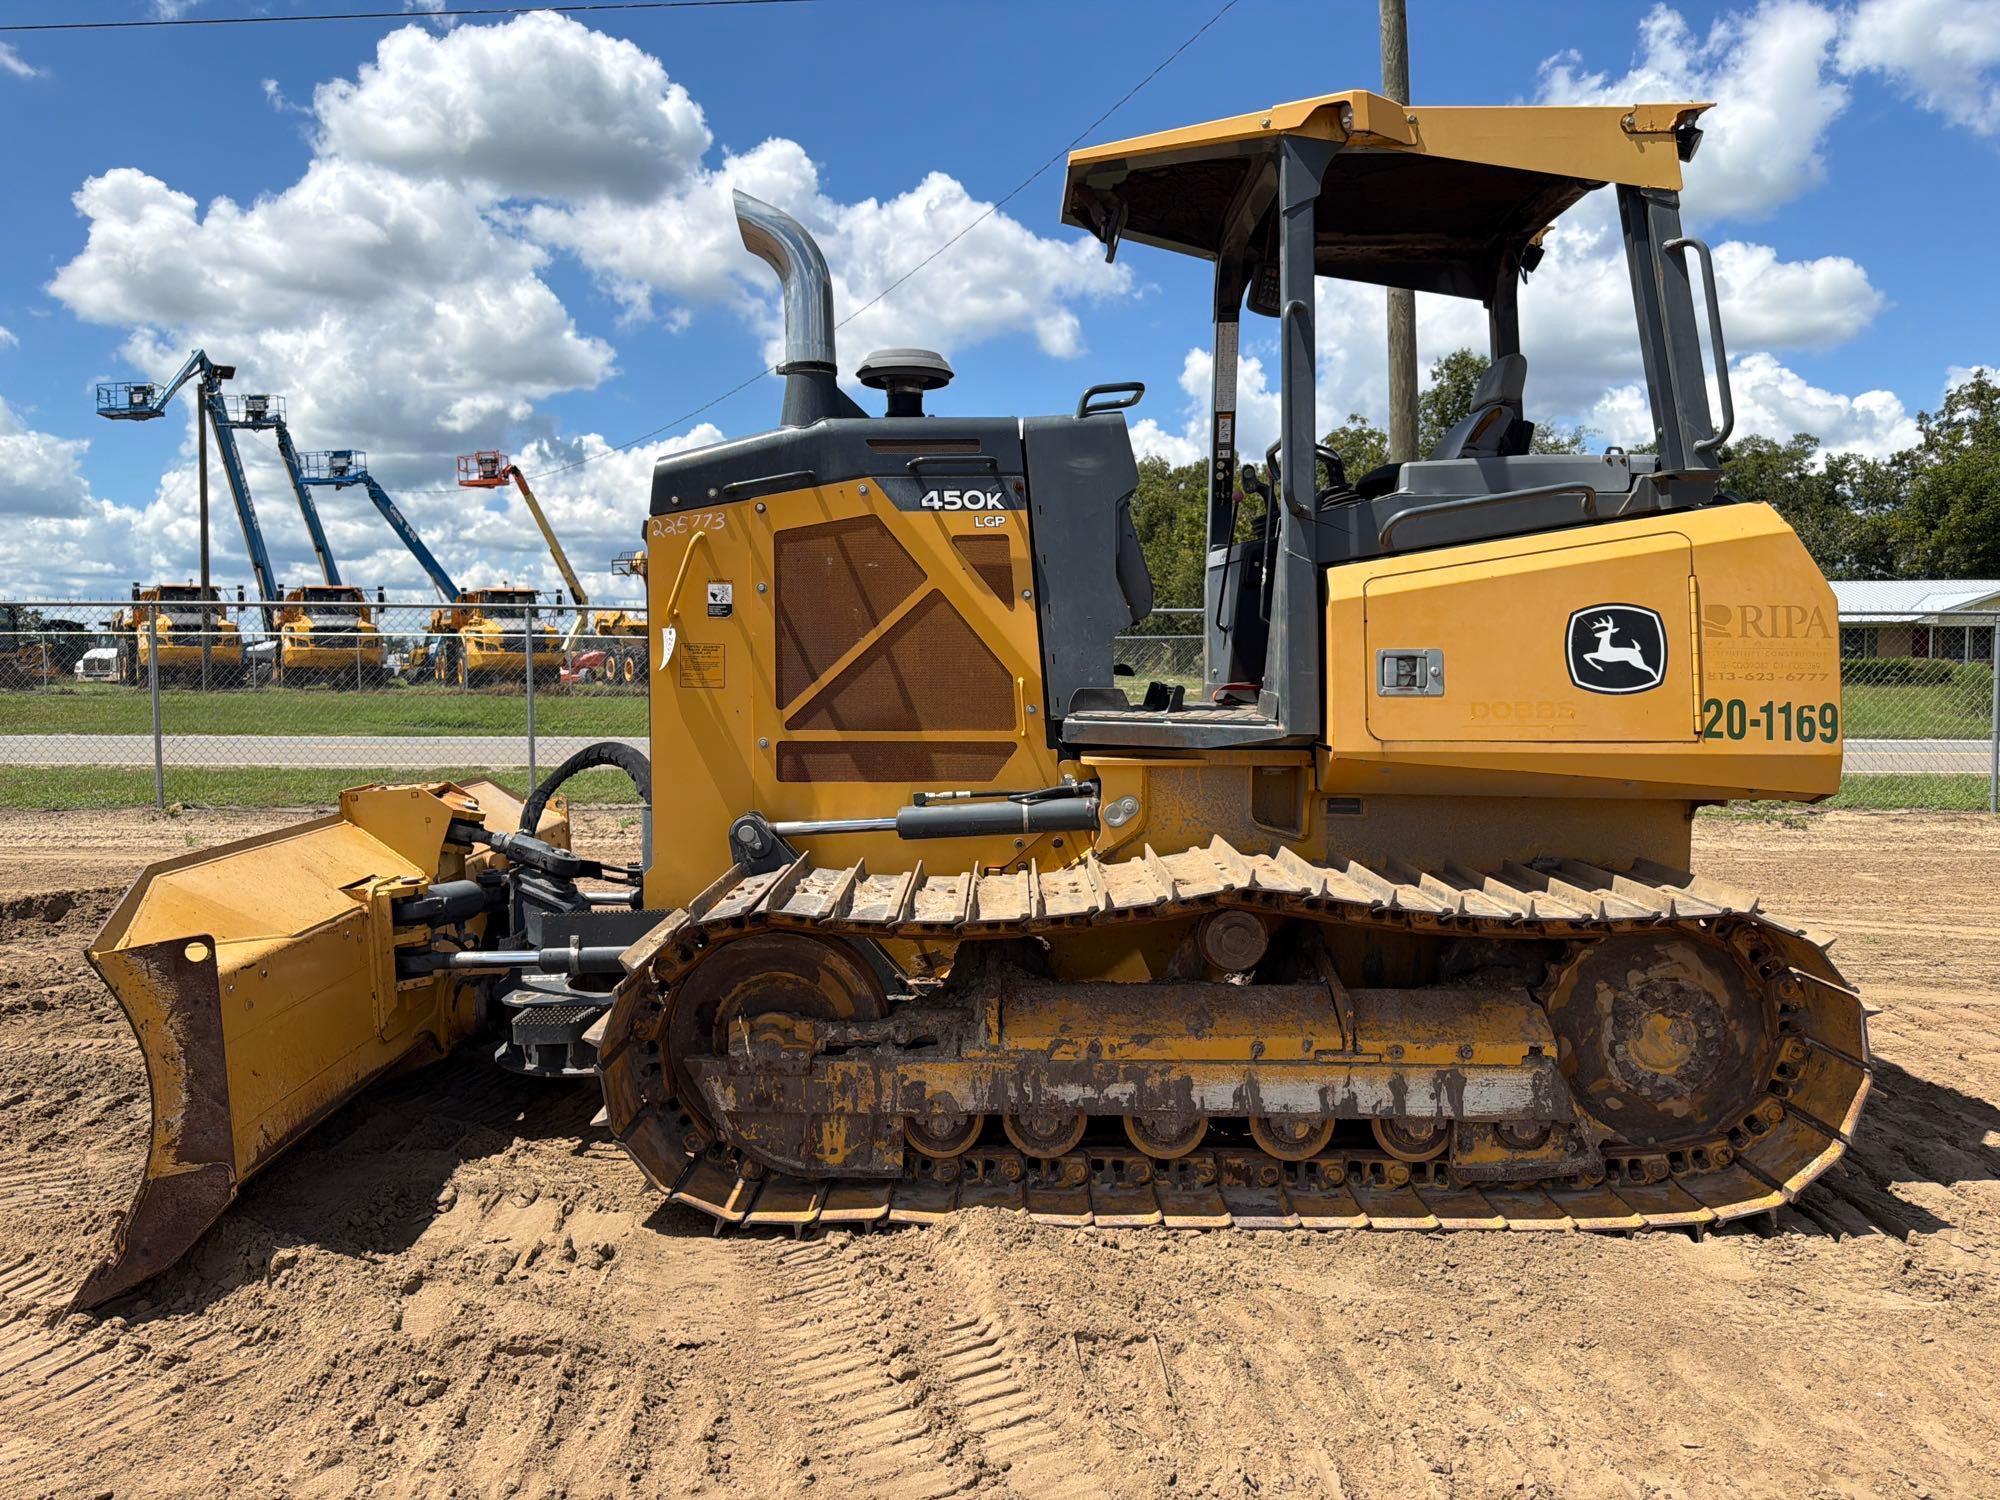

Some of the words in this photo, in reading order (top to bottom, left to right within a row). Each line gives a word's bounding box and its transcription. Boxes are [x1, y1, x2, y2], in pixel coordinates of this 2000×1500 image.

[921, 490, 1004, 510] 450K
[975, 516, 1006, 527] LGP
[1736, 604, 1834, 639] RIPA
[1705, 672, 1829, 682] 813-623-6777
[1703, 698, 1838, 744] 20-1169
